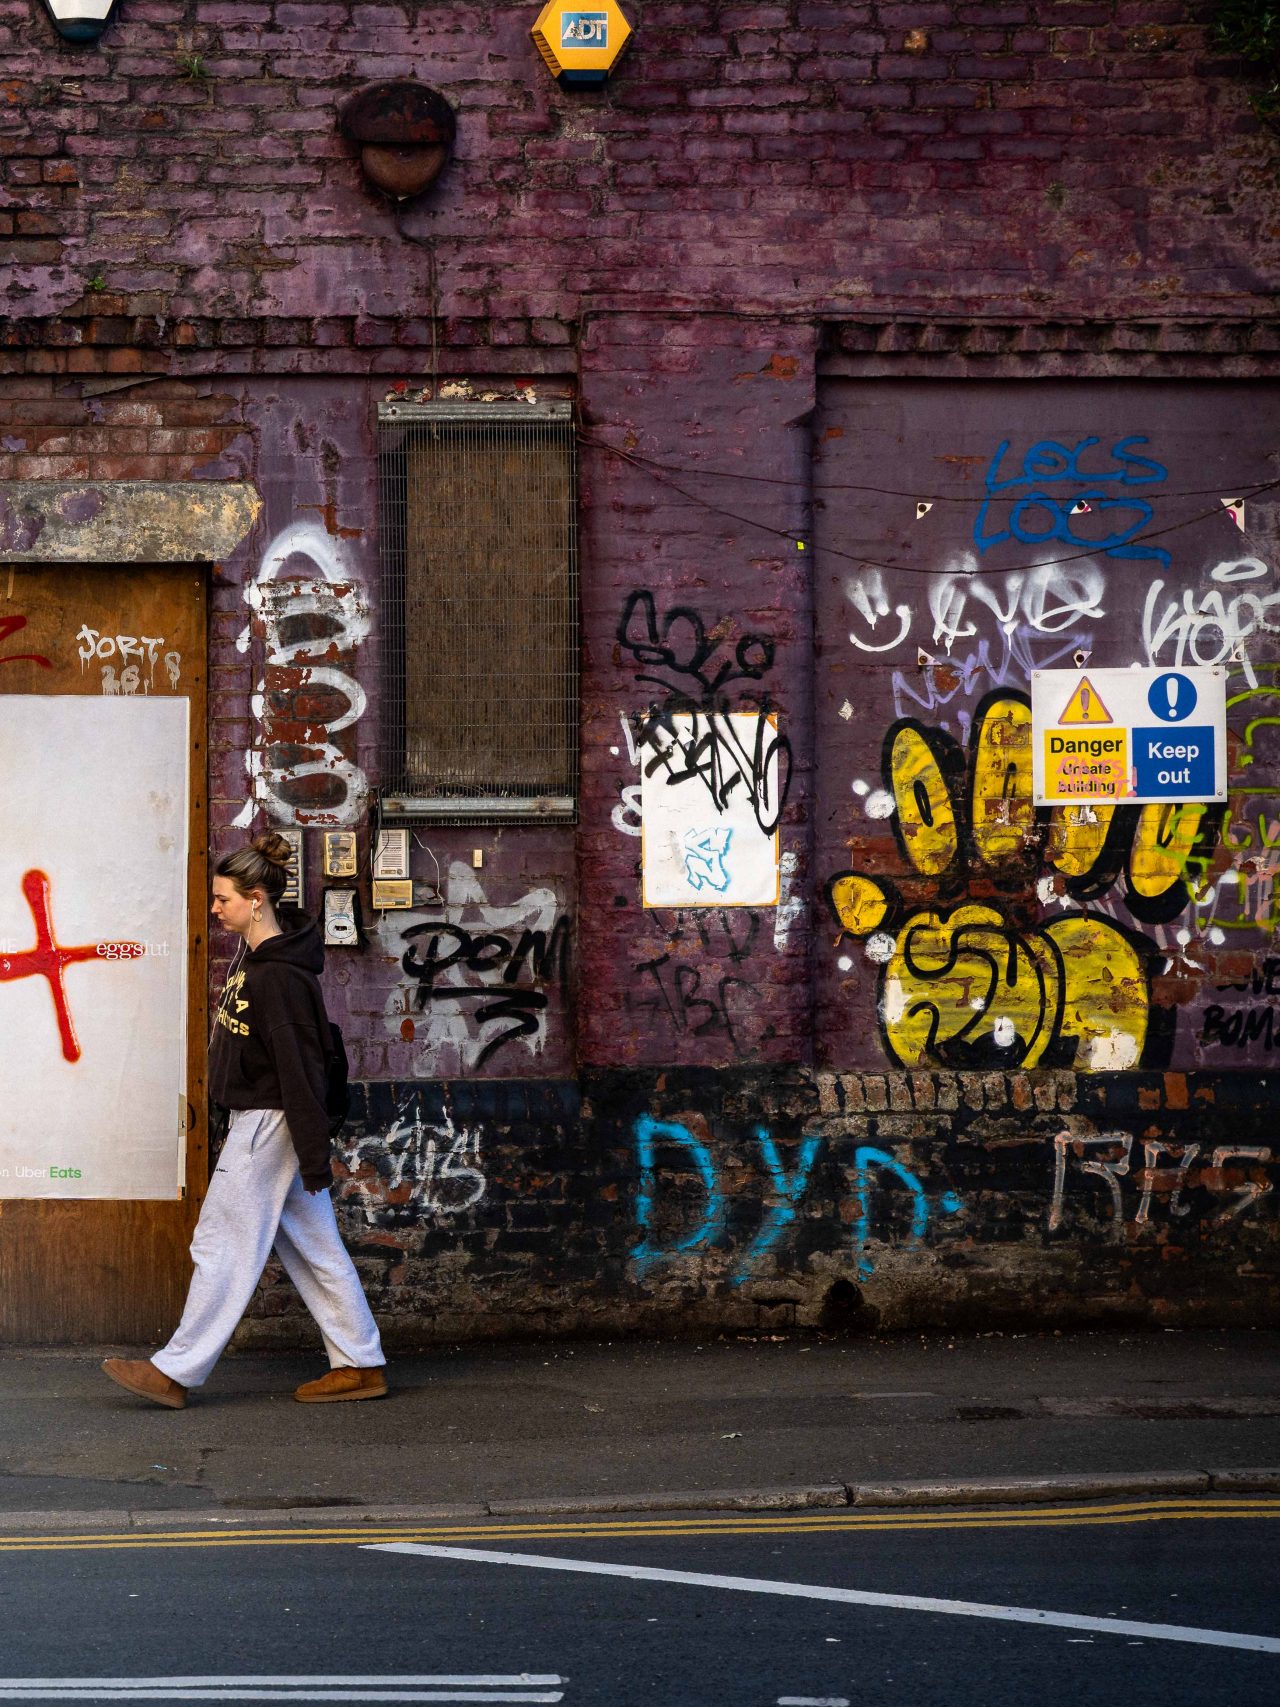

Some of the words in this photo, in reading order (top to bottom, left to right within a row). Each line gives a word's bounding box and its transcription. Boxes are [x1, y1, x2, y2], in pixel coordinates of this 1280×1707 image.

[562, 19, 608, 40] ADT
[1050, 737, 1123, 757] Danger
[1148, 742, 1199, 762] Keep
[1157, 766, 1191, 784] out
[96, 940, 170, 960] eggslut
[15, 1166, 47, 1178] Uber
[49, 1166, 82, 1178] Eats
